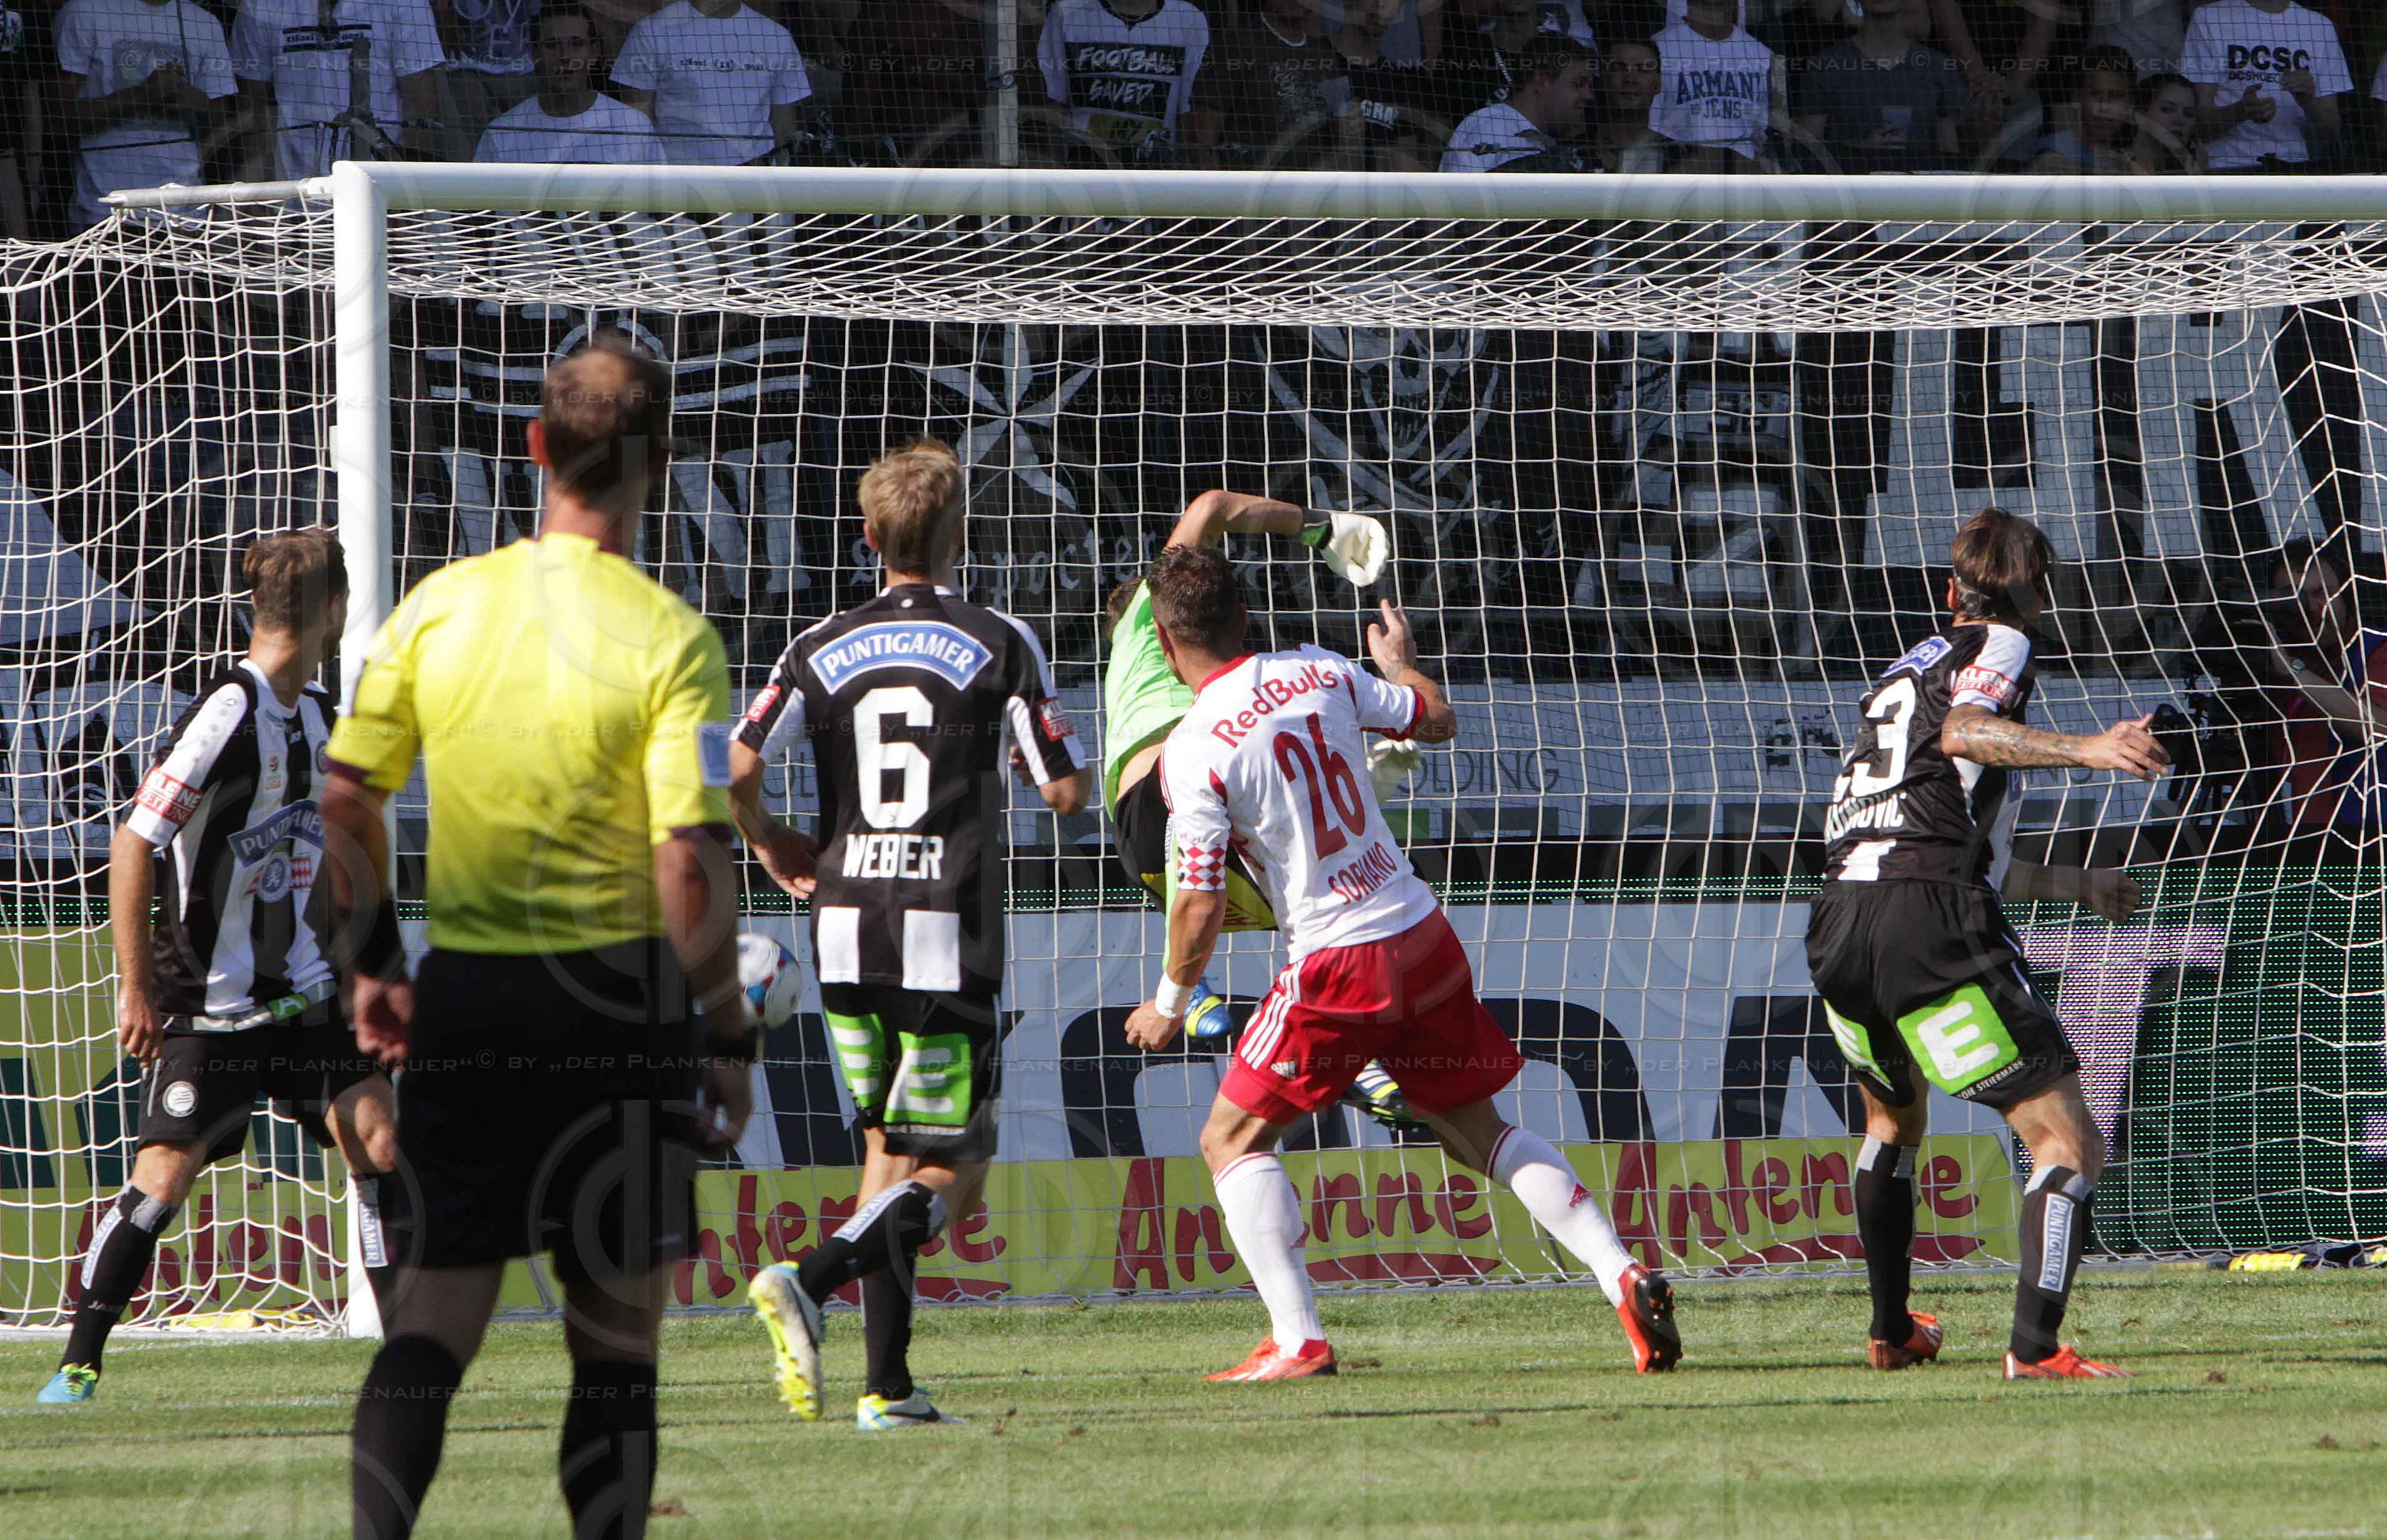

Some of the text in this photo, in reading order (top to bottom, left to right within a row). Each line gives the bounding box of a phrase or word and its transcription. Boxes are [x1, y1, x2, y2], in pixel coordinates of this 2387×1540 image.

[1079, 46, 1175, 74] FOOTBALL
[1090, 79, 1155, 105] SAVED
[822, 631, 976, 678] PUNTIGAMER
[854, 687, 933, 829] 6
[1851, 677, 1916, 797] 3
[140, 769, 202, 810] KLEINE
[1272, 712, 1365, 861] 26
[843, 834, 944, 879] WEBER
[1328, 841, 1397, 906] SORIANO
[1977, 1060, 2027, 1091] STEIERMARK
[1112, 1158, 1493, 1291] Annne
[1611, 1138, 1979, 1274] Antene
[2045, 1199, 2068, 1285] PUNTIGAMER
